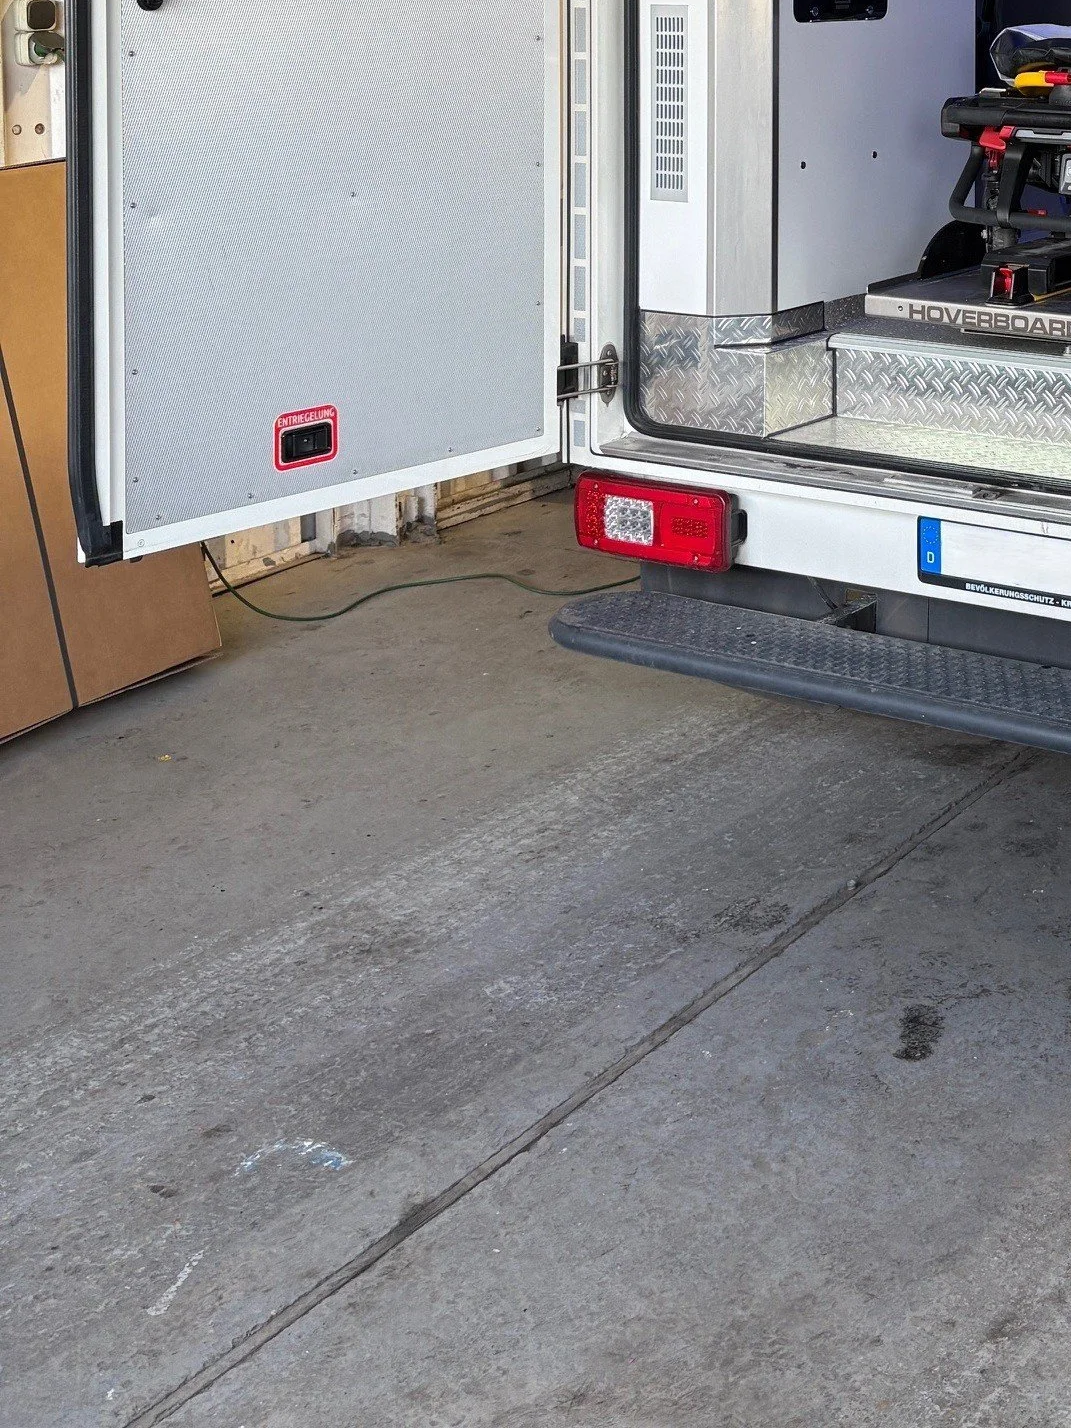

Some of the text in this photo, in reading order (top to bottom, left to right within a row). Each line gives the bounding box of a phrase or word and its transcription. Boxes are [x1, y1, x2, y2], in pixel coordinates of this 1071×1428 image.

[277, 407, 335, 428] ENTRIEGELUNG
[926, 550, 935, 564] D
[965, 582, 1055, 605] BEVÖLKERUNGSSCHUTZ
